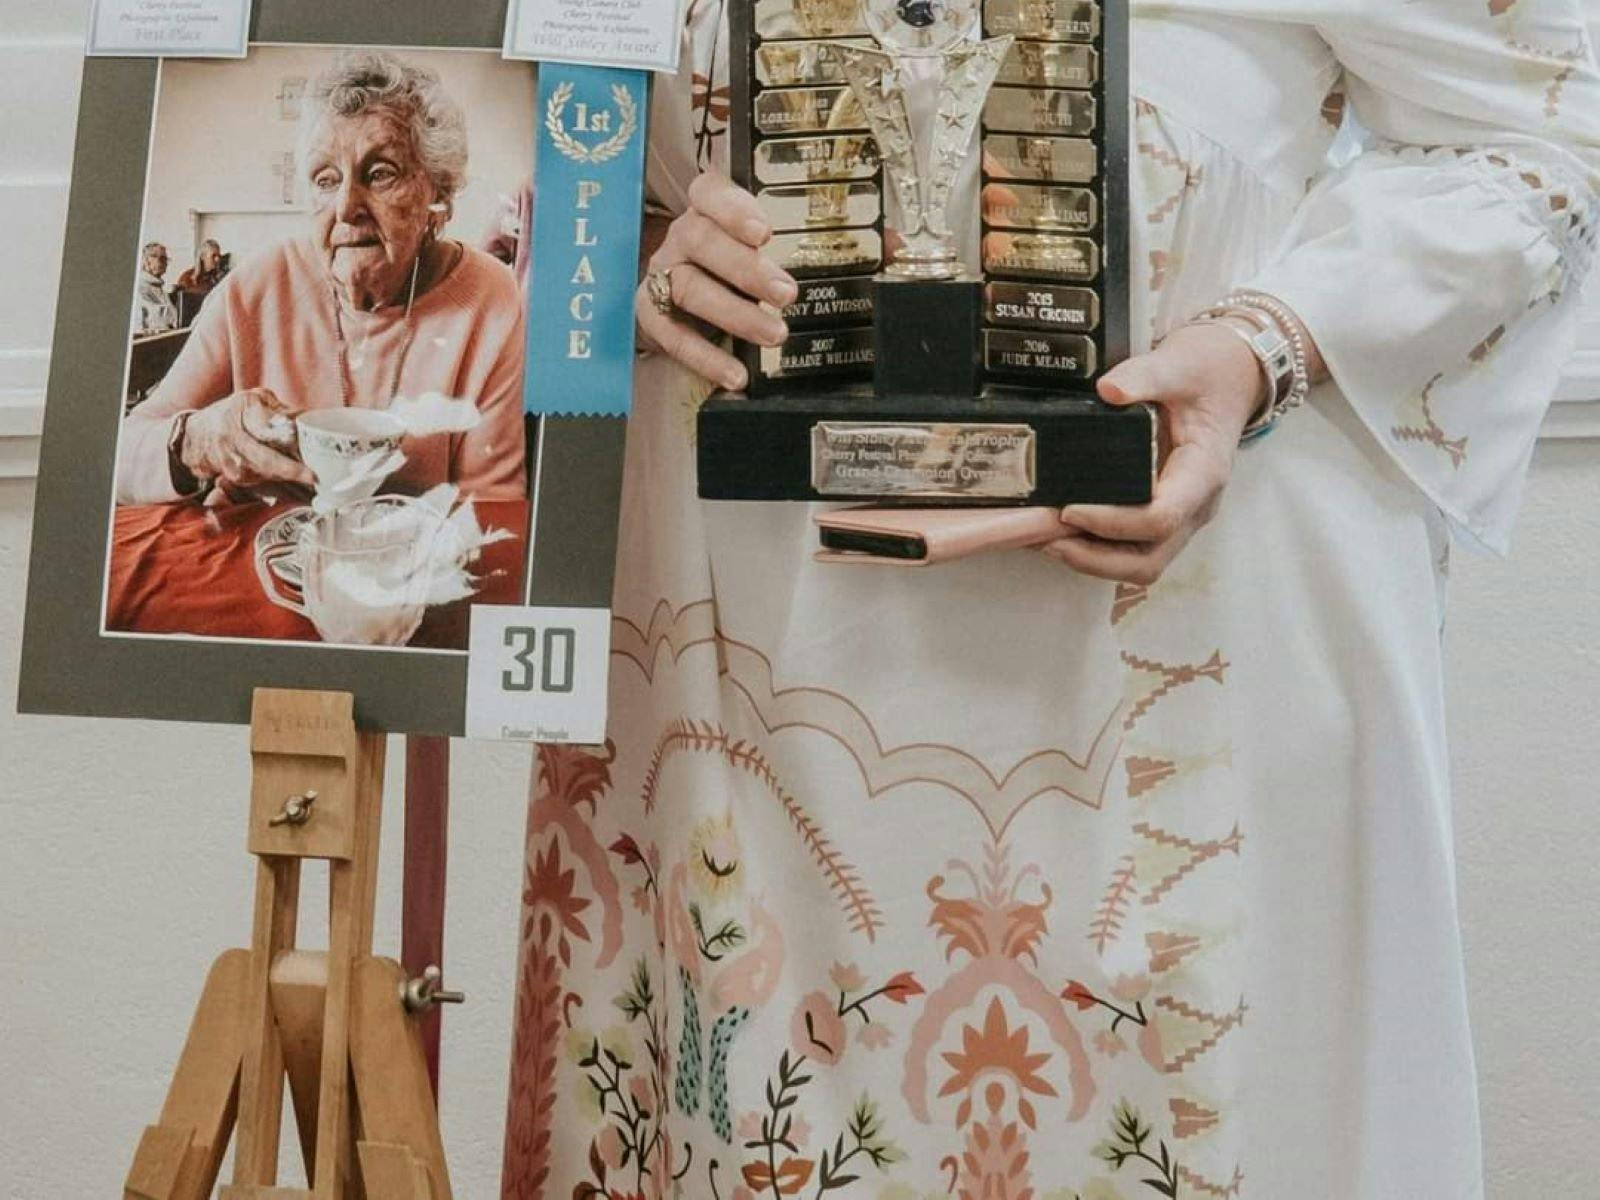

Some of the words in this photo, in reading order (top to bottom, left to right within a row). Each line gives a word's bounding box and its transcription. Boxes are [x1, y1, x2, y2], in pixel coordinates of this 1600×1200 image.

[572, 103, 610, 132] 1st
[568, 181, 601, 359] PLACE
[805, 286, 836, 301] 2006
[813, 298, 874, 315] DAVIDSON
[995, 304, 1036, 318] SUSAN
[1039, 307, 1085, 323] CRONIN
[1001, 352, 1031, 367] JUDE
[1034, 355, 1078, 371] MEADS
[502, 626, 575, 692] 30
